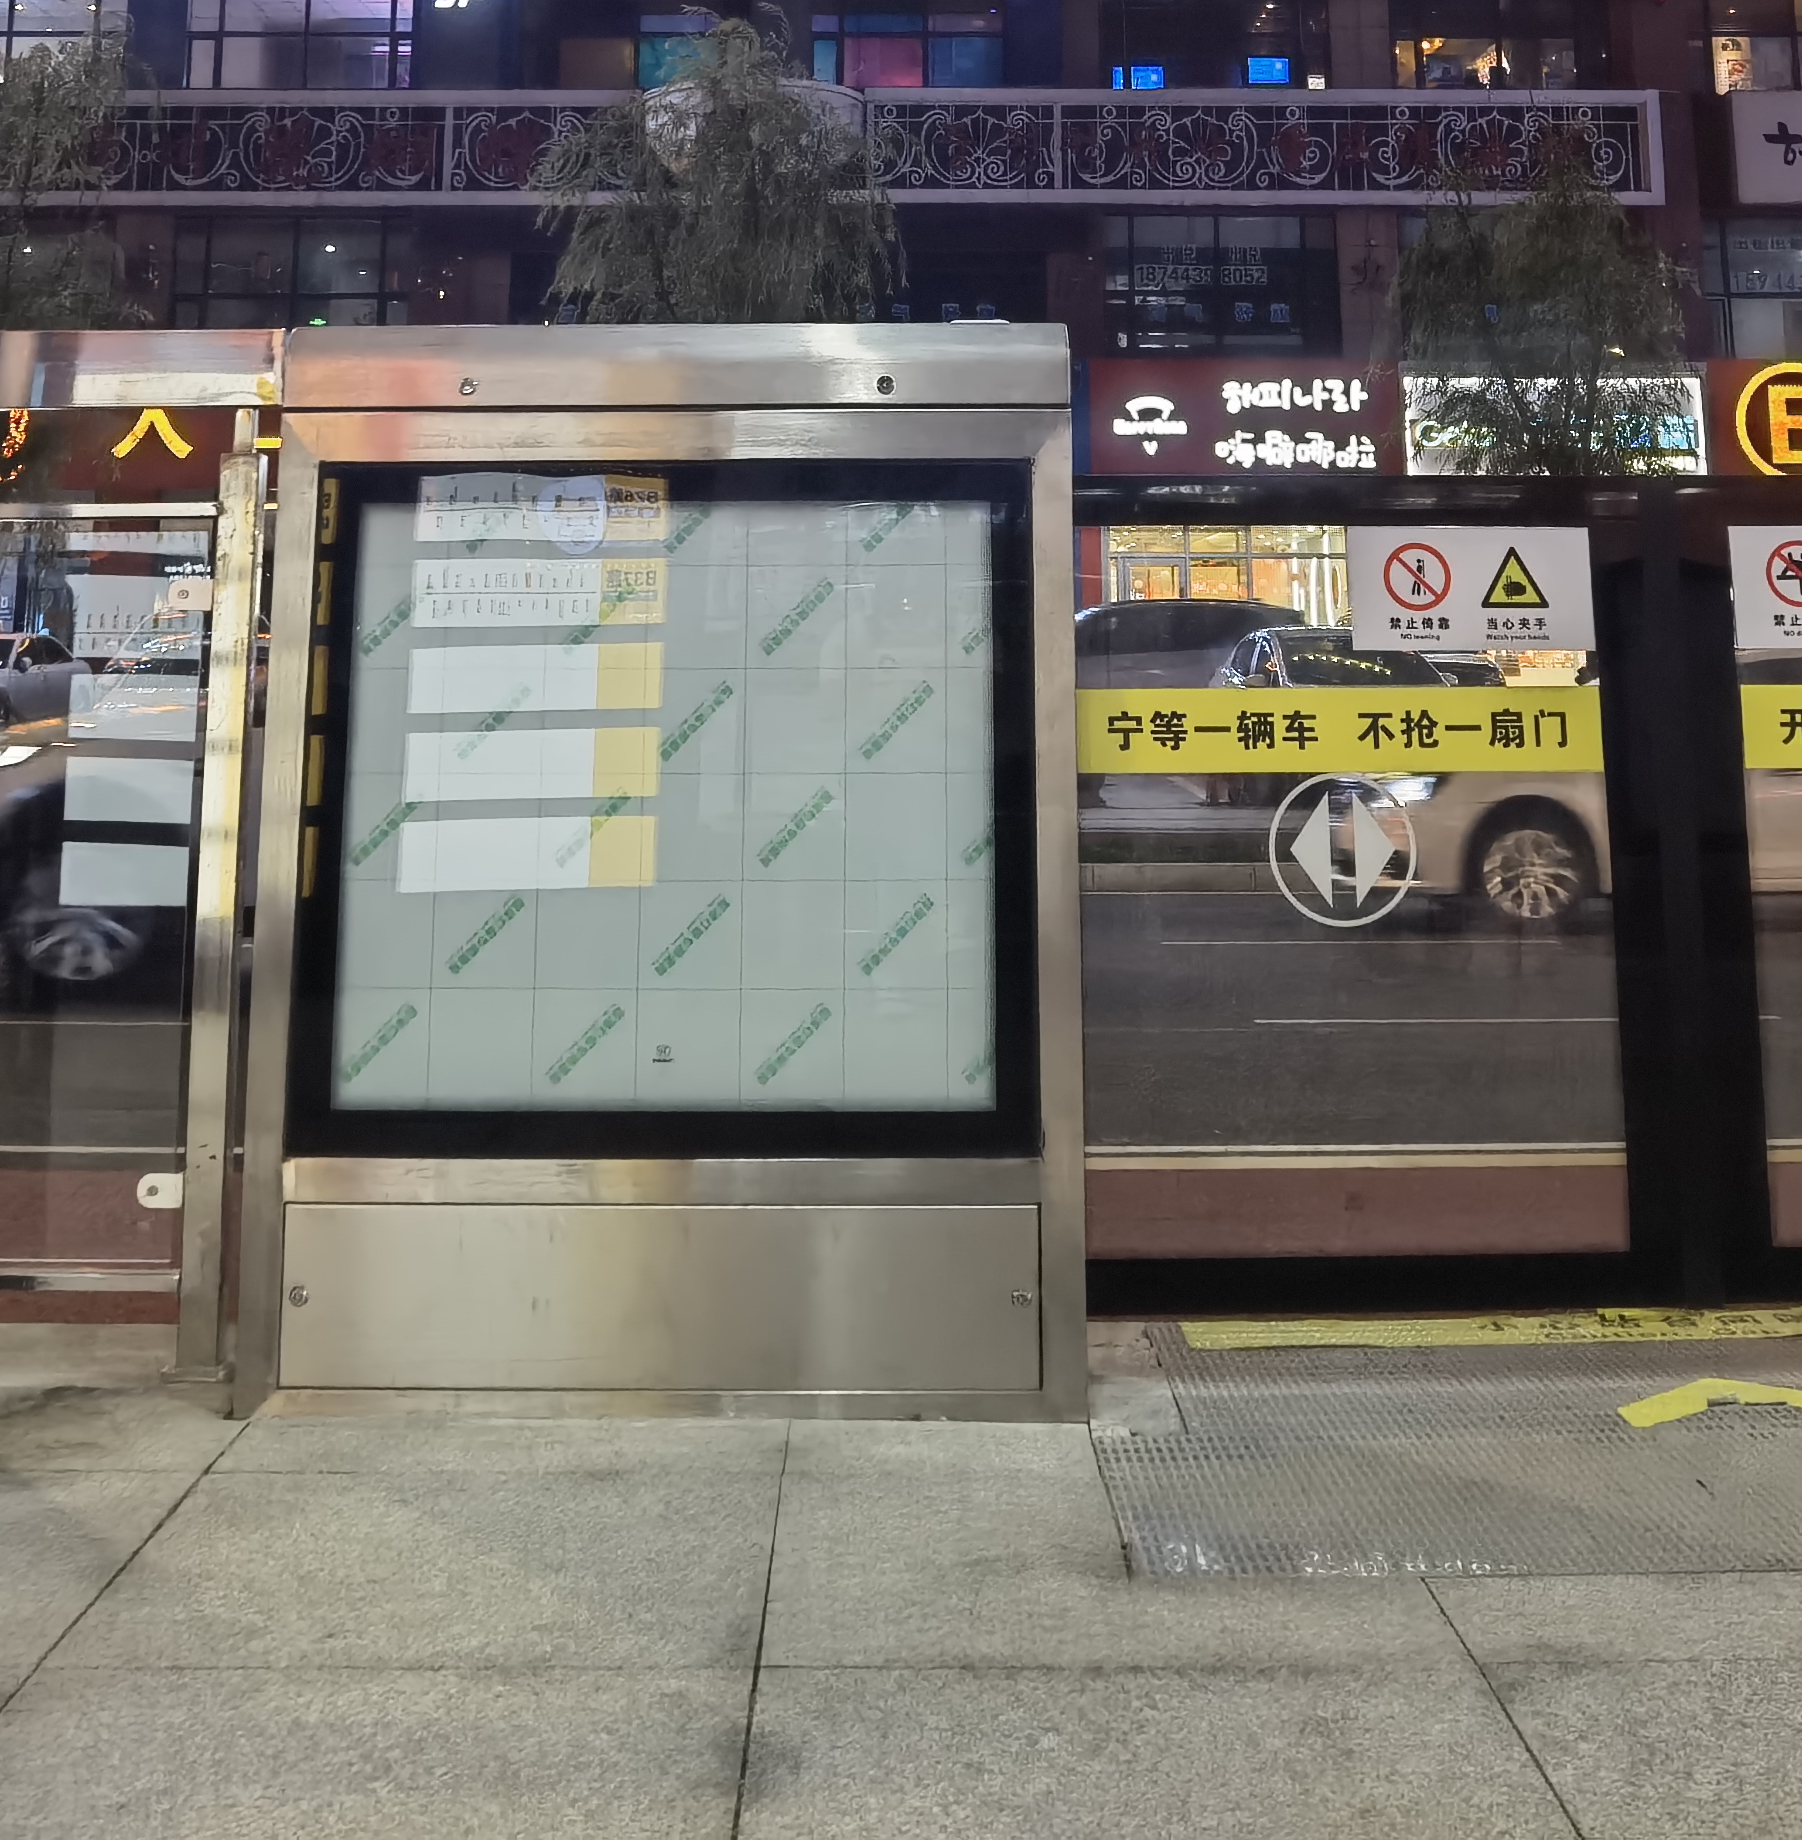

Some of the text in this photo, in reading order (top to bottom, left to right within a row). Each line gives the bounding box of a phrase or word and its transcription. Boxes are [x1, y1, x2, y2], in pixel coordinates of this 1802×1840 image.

[1389, 617, 1451, 630] 禁止倚靠
[1486, 618, 1548, 631] 当心夹手
[1106, 710, 1570, 752] 宁等一辆车 不抢一扇门
